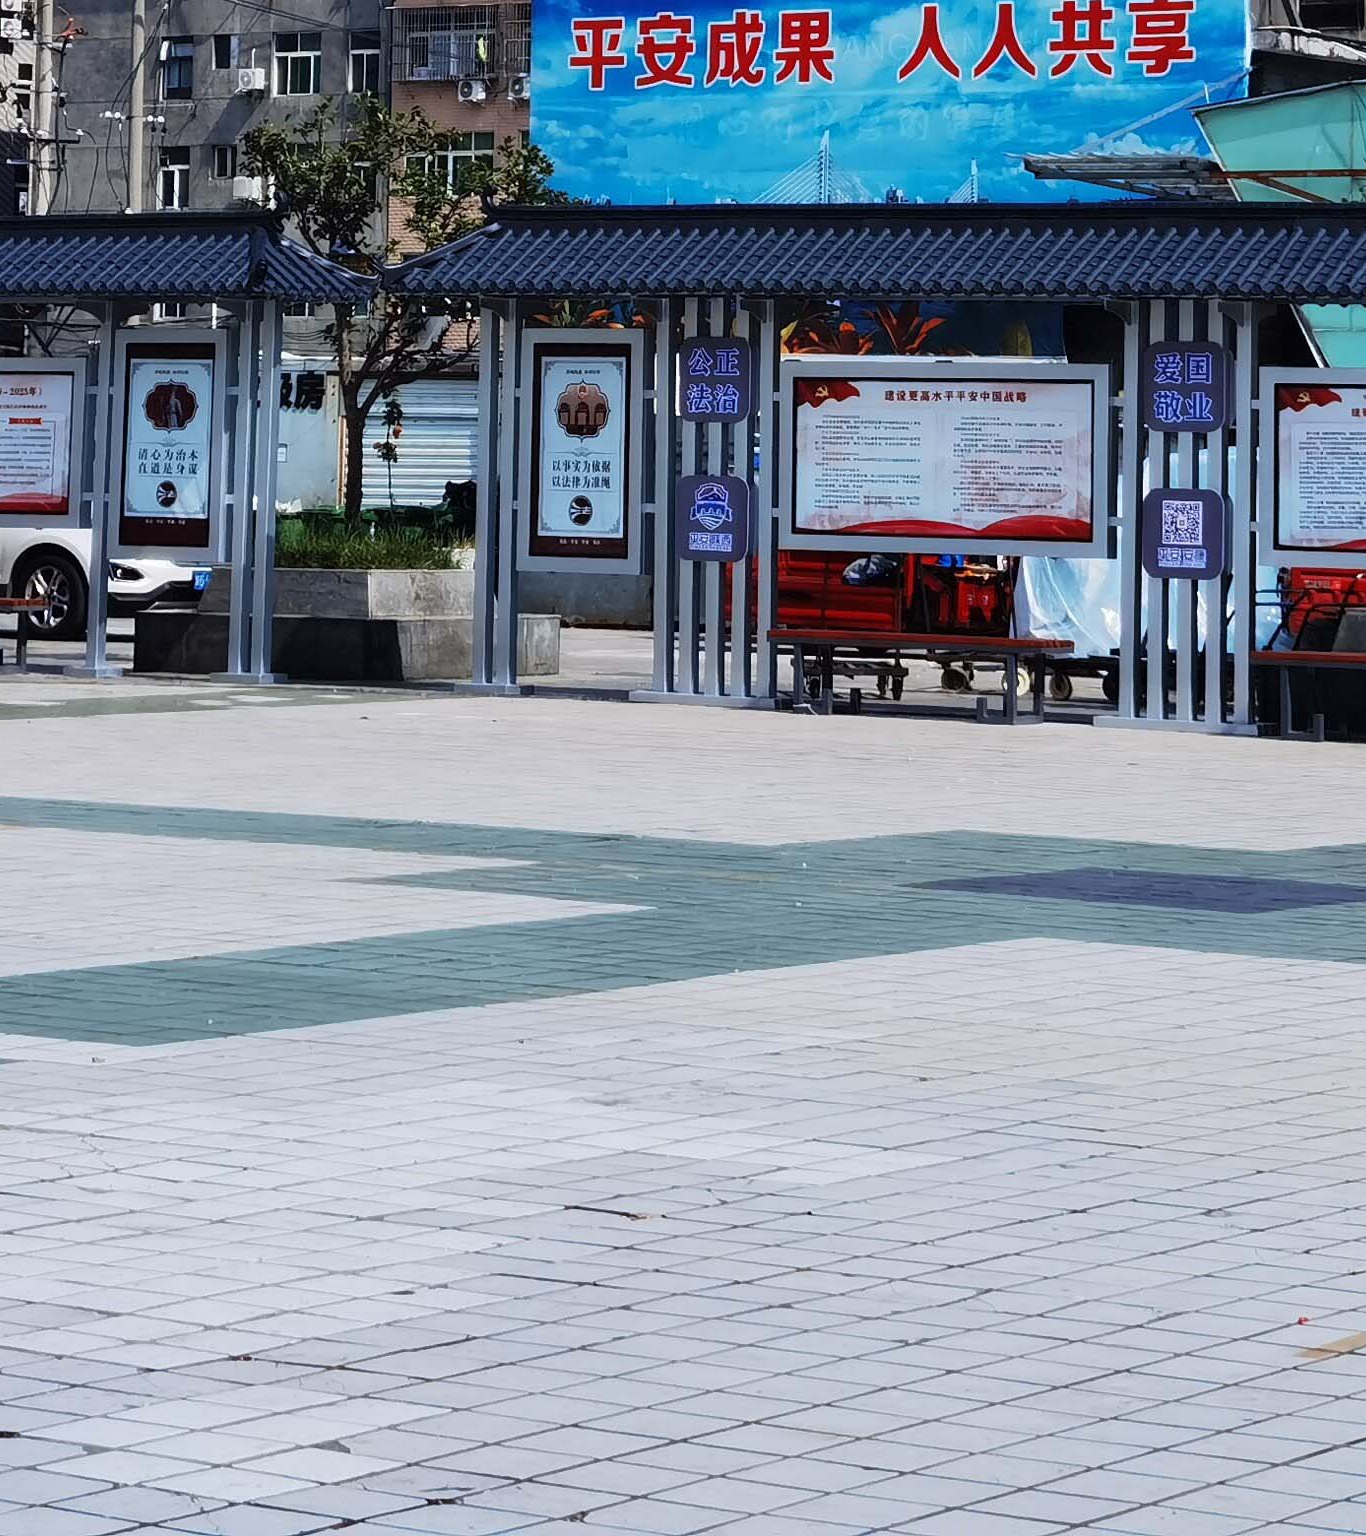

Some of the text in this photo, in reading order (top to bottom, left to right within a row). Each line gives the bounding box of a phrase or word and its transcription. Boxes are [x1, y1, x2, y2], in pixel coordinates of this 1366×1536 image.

[567, 8, 837, 91] 平安成果
[688, 347, 740, 377] 公正
[1154, 352, 1213, 385] 爱国
[686, 383, 740, 414] 法治
[884, 389, 1028, 405] 建设更高水平平安中国战略
[1153, 391, 1213, 423] 敬业
[138, 447, 200, 462] 清心为治本
[552, 458, 612, 474] 以事实为依据
[552, 474, 612, 490] 以法律为准绳
